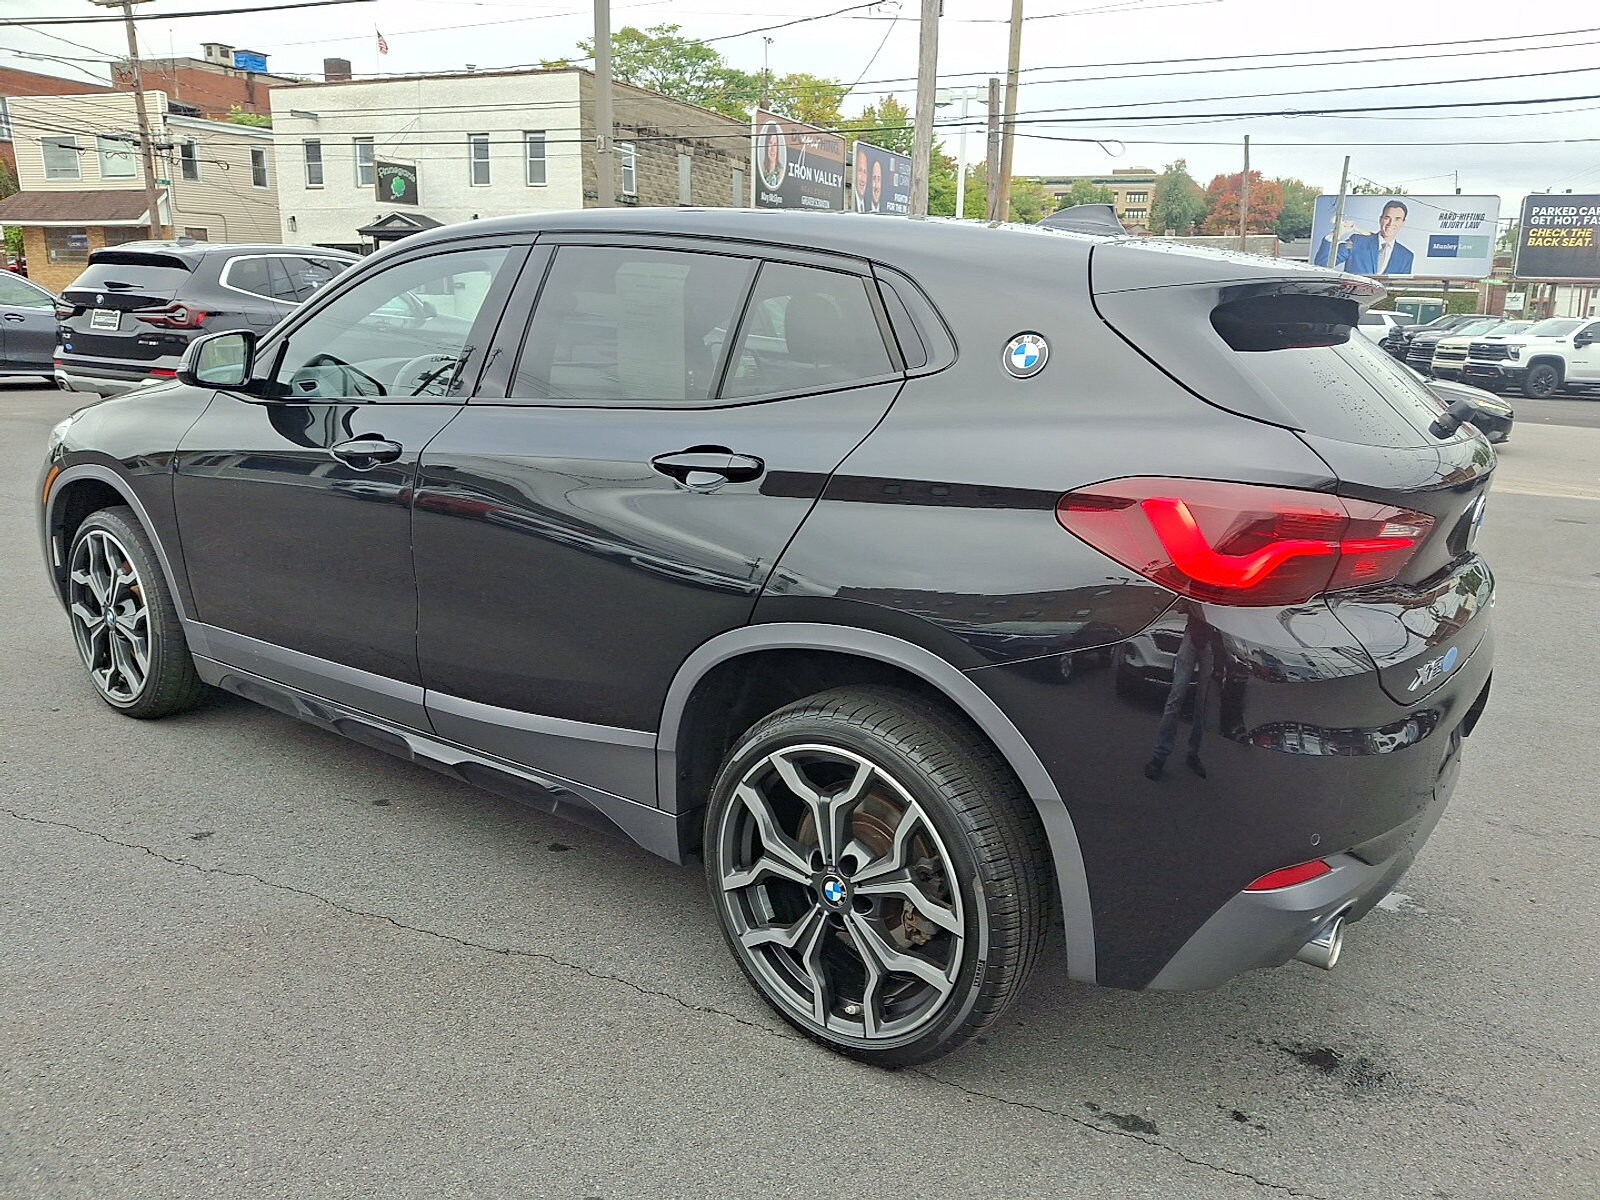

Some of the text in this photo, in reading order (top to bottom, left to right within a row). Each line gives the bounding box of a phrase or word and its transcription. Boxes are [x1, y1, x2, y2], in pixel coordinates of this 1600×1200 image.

[788, 162, 843, 188] IRON VALLEY
[1532, 206, 1577, 216] PARKED
[1440, 221, 1481, 229] INJURY LAW
[1530, 216, 1600, 226] GET HOT, FA
[1529, 228, 1594, 237] CHECK THE
[1432, 242, 1457, 251] Munley
[1527, 237, 1594, 247] BACK SEAT.
